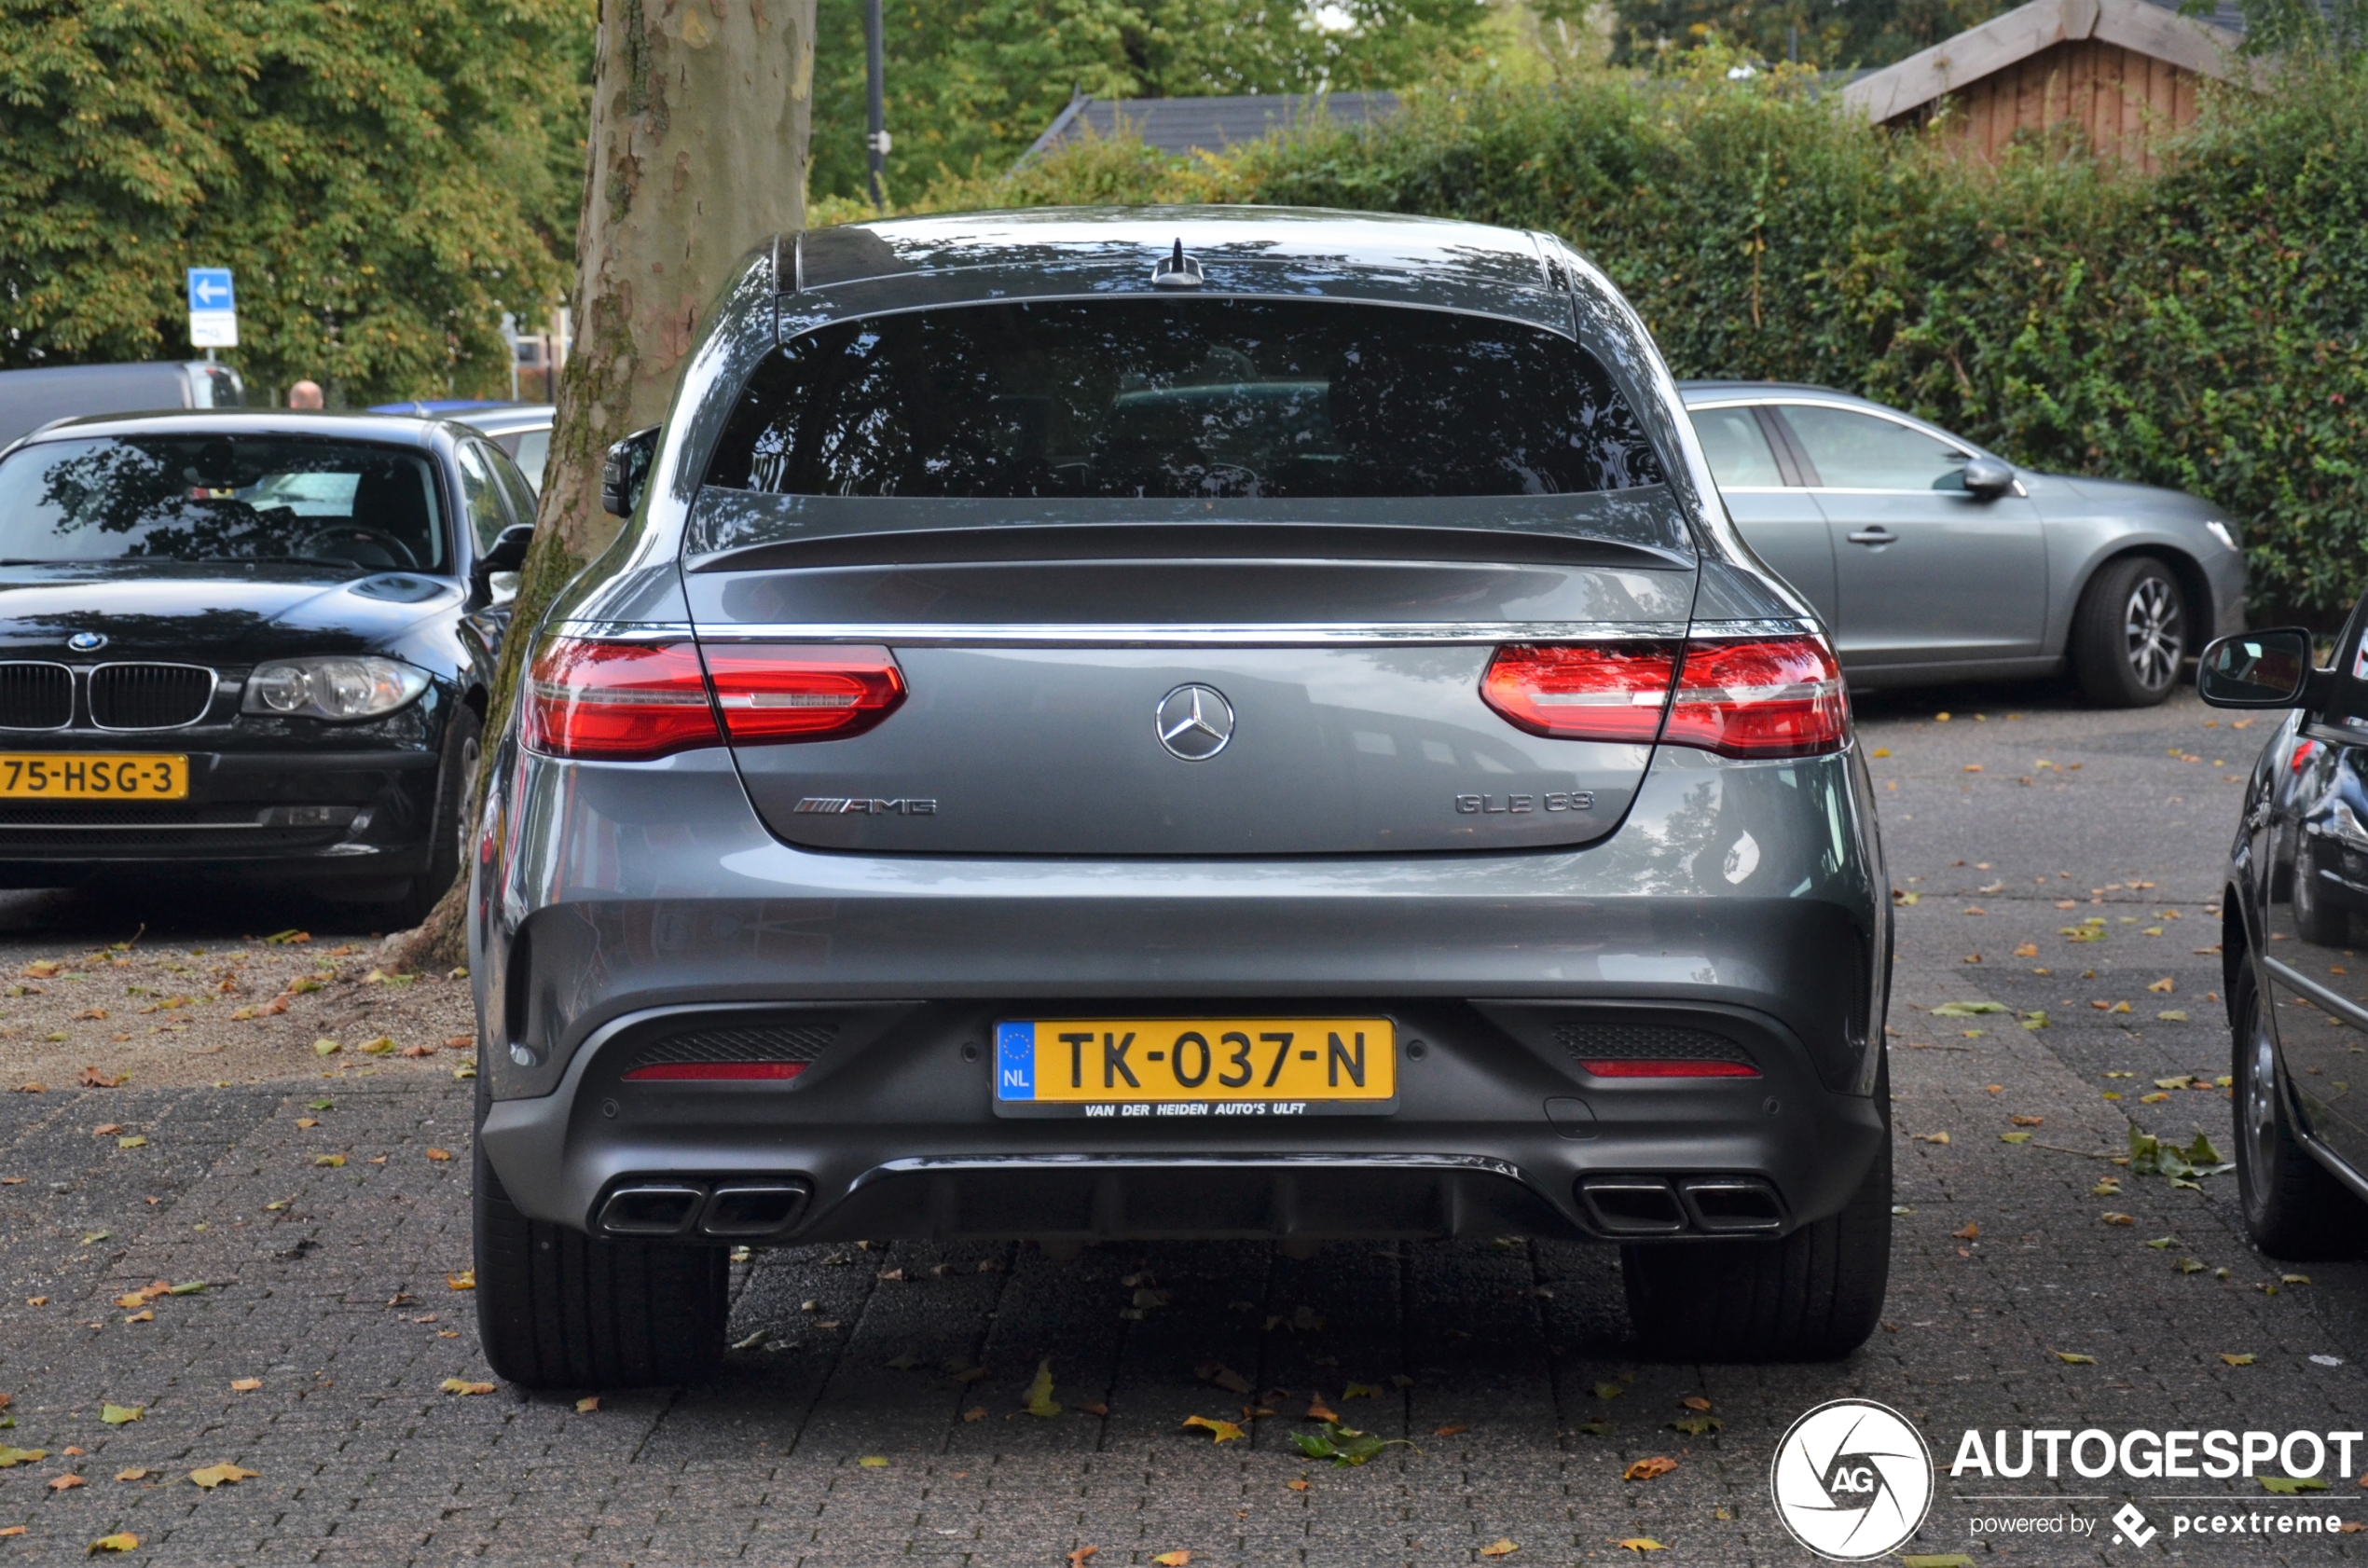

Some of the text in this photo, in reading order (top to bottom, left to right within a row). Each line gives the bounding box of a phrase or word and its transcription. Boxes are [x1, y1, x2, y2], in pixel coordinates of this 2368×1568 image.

[4, 761, 172, 792] 75-HSG-3
[840, 799, 936, 815] AMG
[1455, 791, 1595, 814] GLE 63
[1058, 1031, 1365, 1089] TK-037-N
[1004, 1069, 1029, 1087] NL
[1085, 1102, 1306, 1117] VAN DER HEIDEN AUTO'S ULFT
